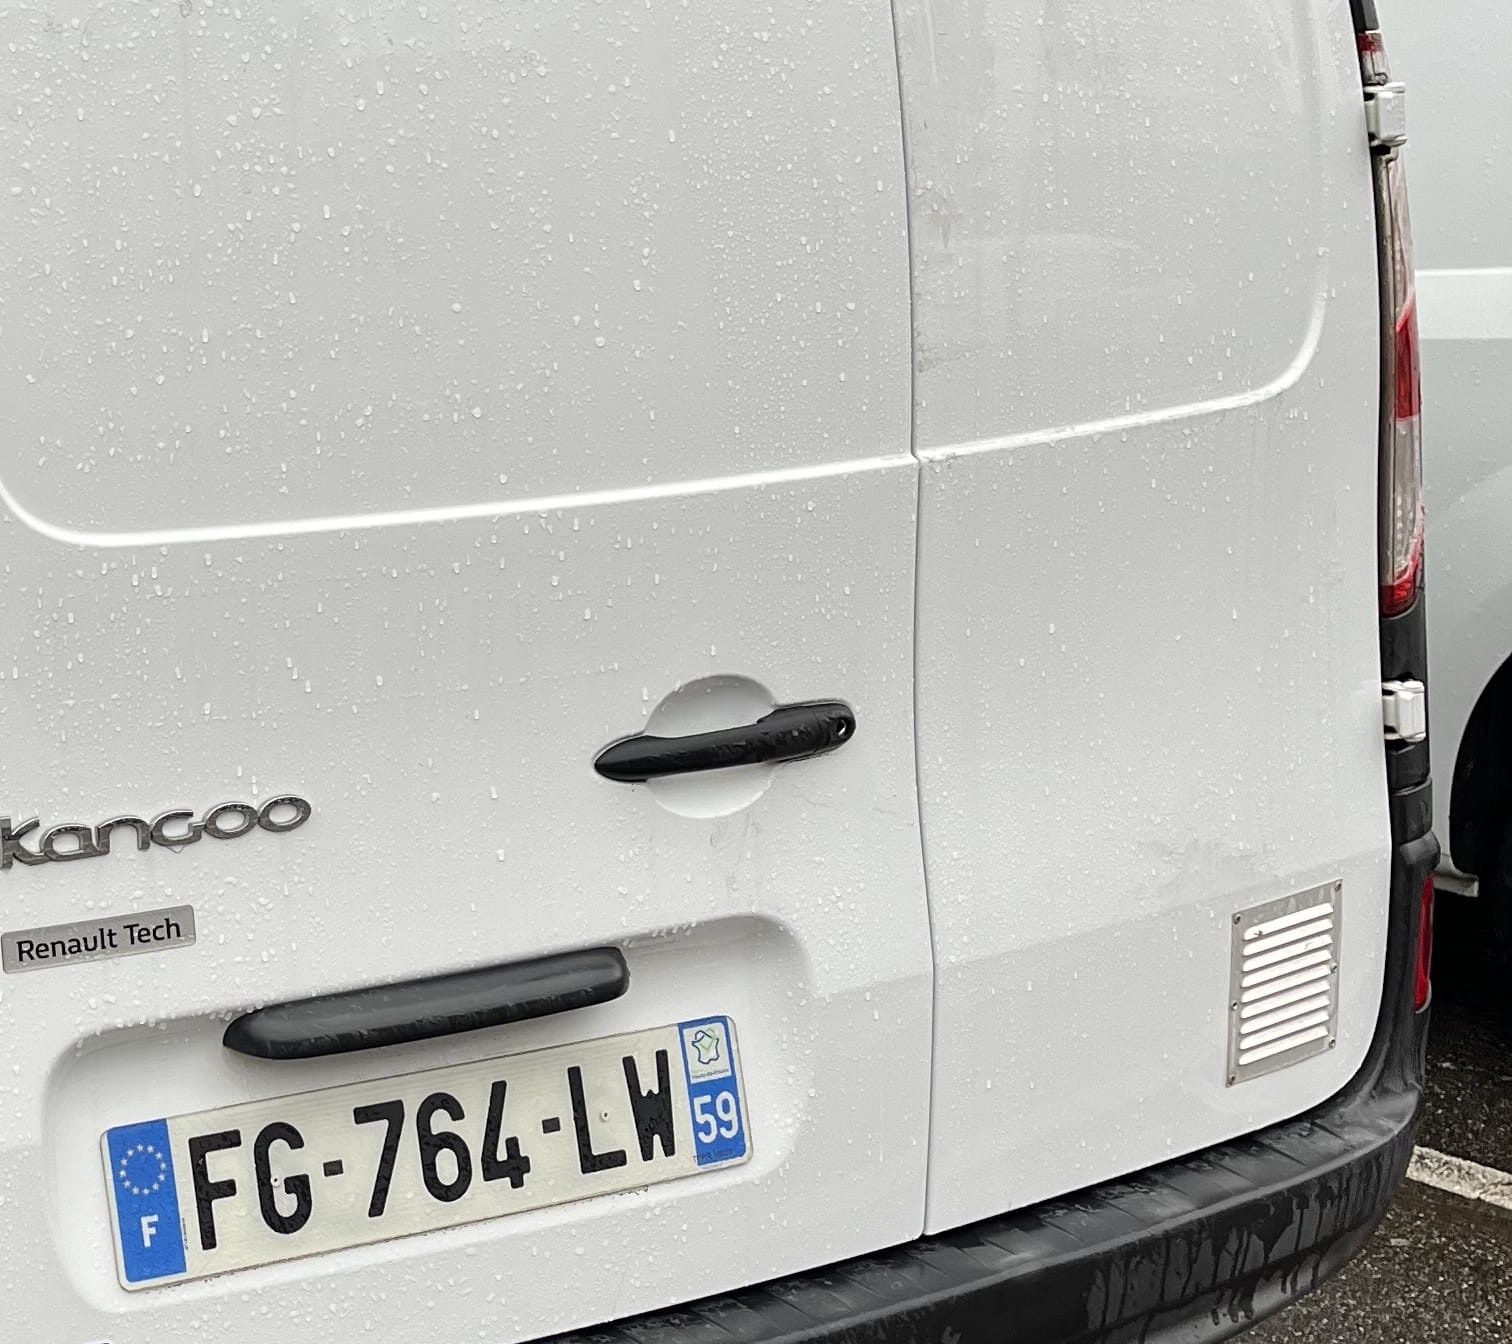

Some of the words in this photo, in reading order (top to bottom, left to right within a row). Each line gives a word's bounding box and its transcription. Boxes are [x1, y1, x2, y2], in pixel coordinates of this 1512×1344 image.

[16, 928, 119, 962] Renault
[123, 917, 182, 946] Tech
[140, 1213, 159, 1248] F
[187, 1048, 678, 1252] FG-764-LW
[693, 1090, 739, 1144] 59
